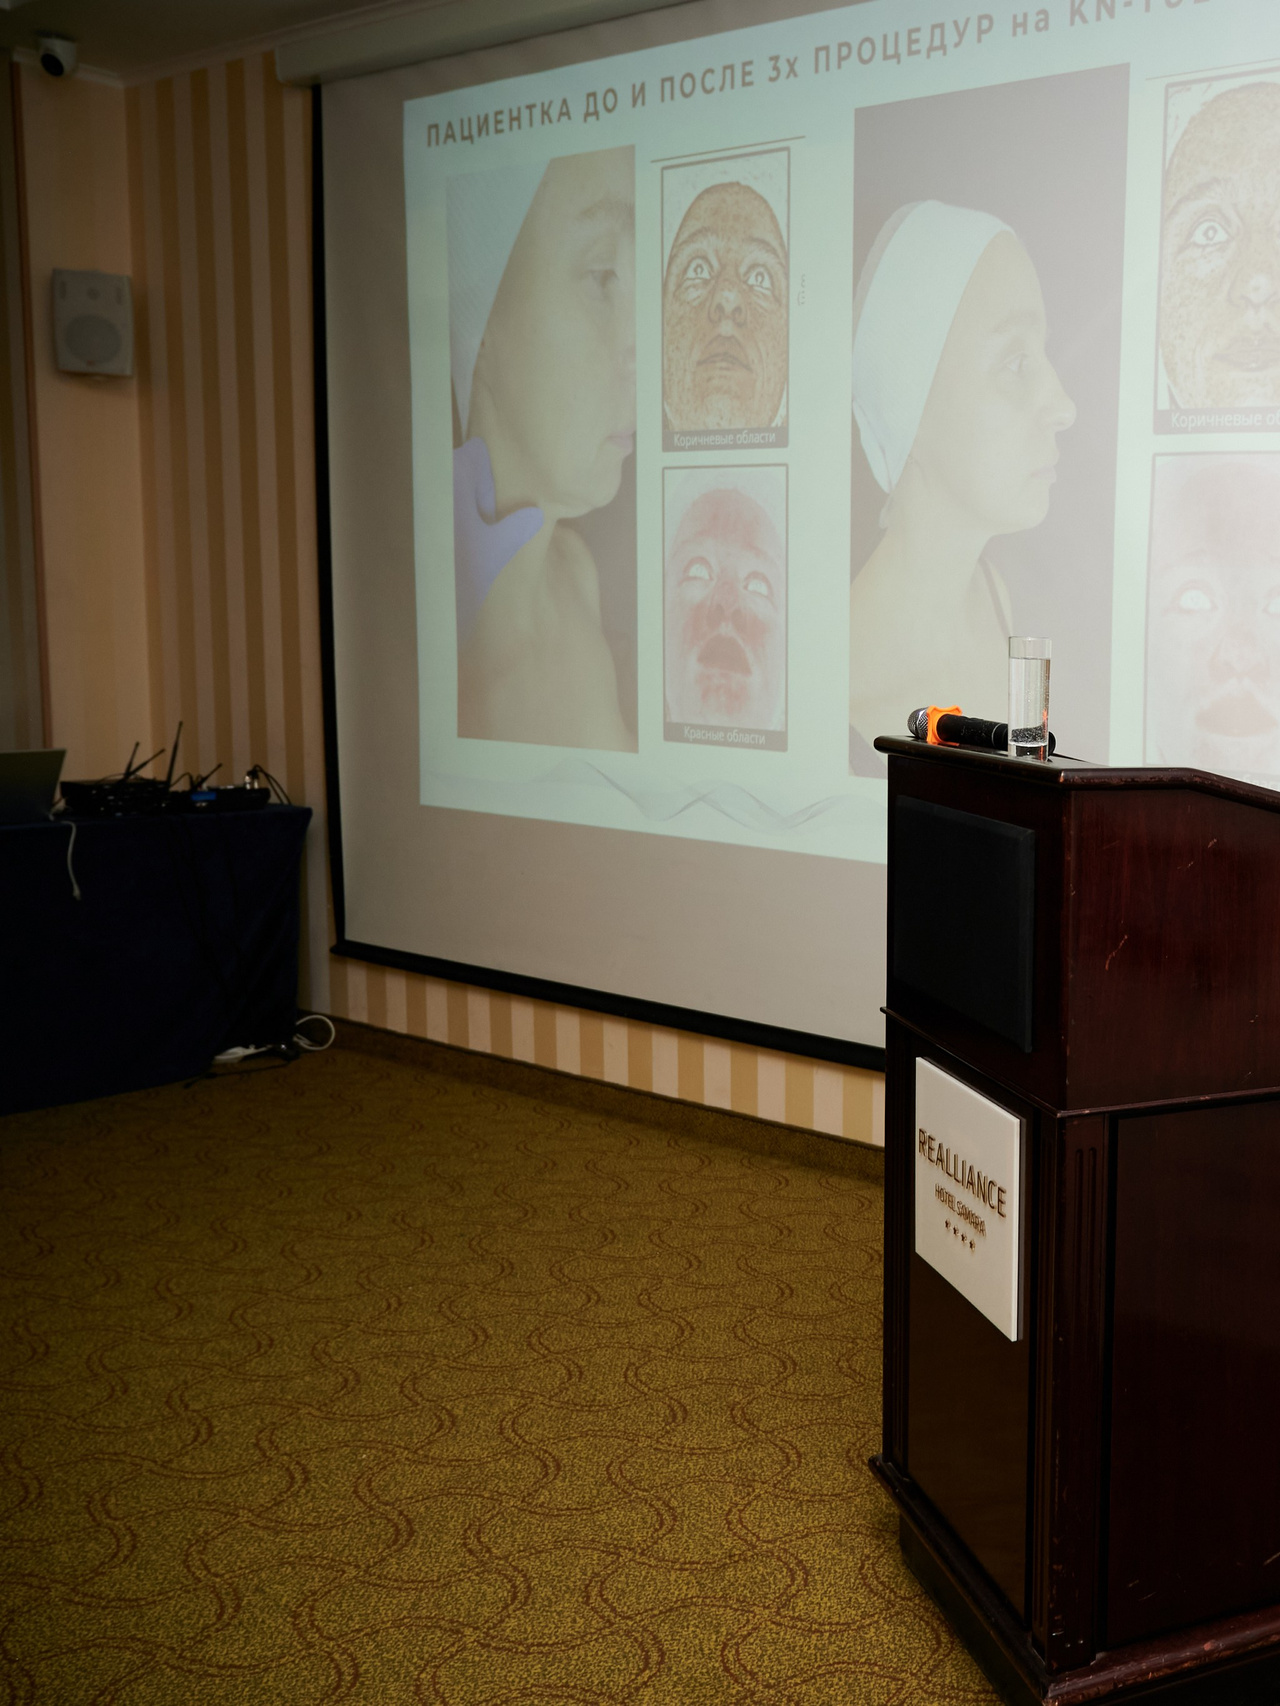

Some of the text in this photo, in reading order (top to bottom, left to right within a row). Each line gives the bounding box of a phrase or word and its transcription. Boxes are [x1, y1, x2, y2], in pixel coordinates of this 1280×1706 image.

[427, 98, 572, 147] ПАЦИЕНТКА
[583, 88, 618, 122] ДО
[632, 81, 646, 108] И
[661, 60, 754, 103] ПОСЛЕ
[814, 13, 994, 74] ПРОЦЕДУР
[1011, 8, 1050, 37] на
[1171, 411, 1262, 431] Коричневые
[674, 430, 776, 449] Коричневые области
[684, 726, 766, 745] Красные области
[918, 1128, 1007, 1219] REALLIANCE
